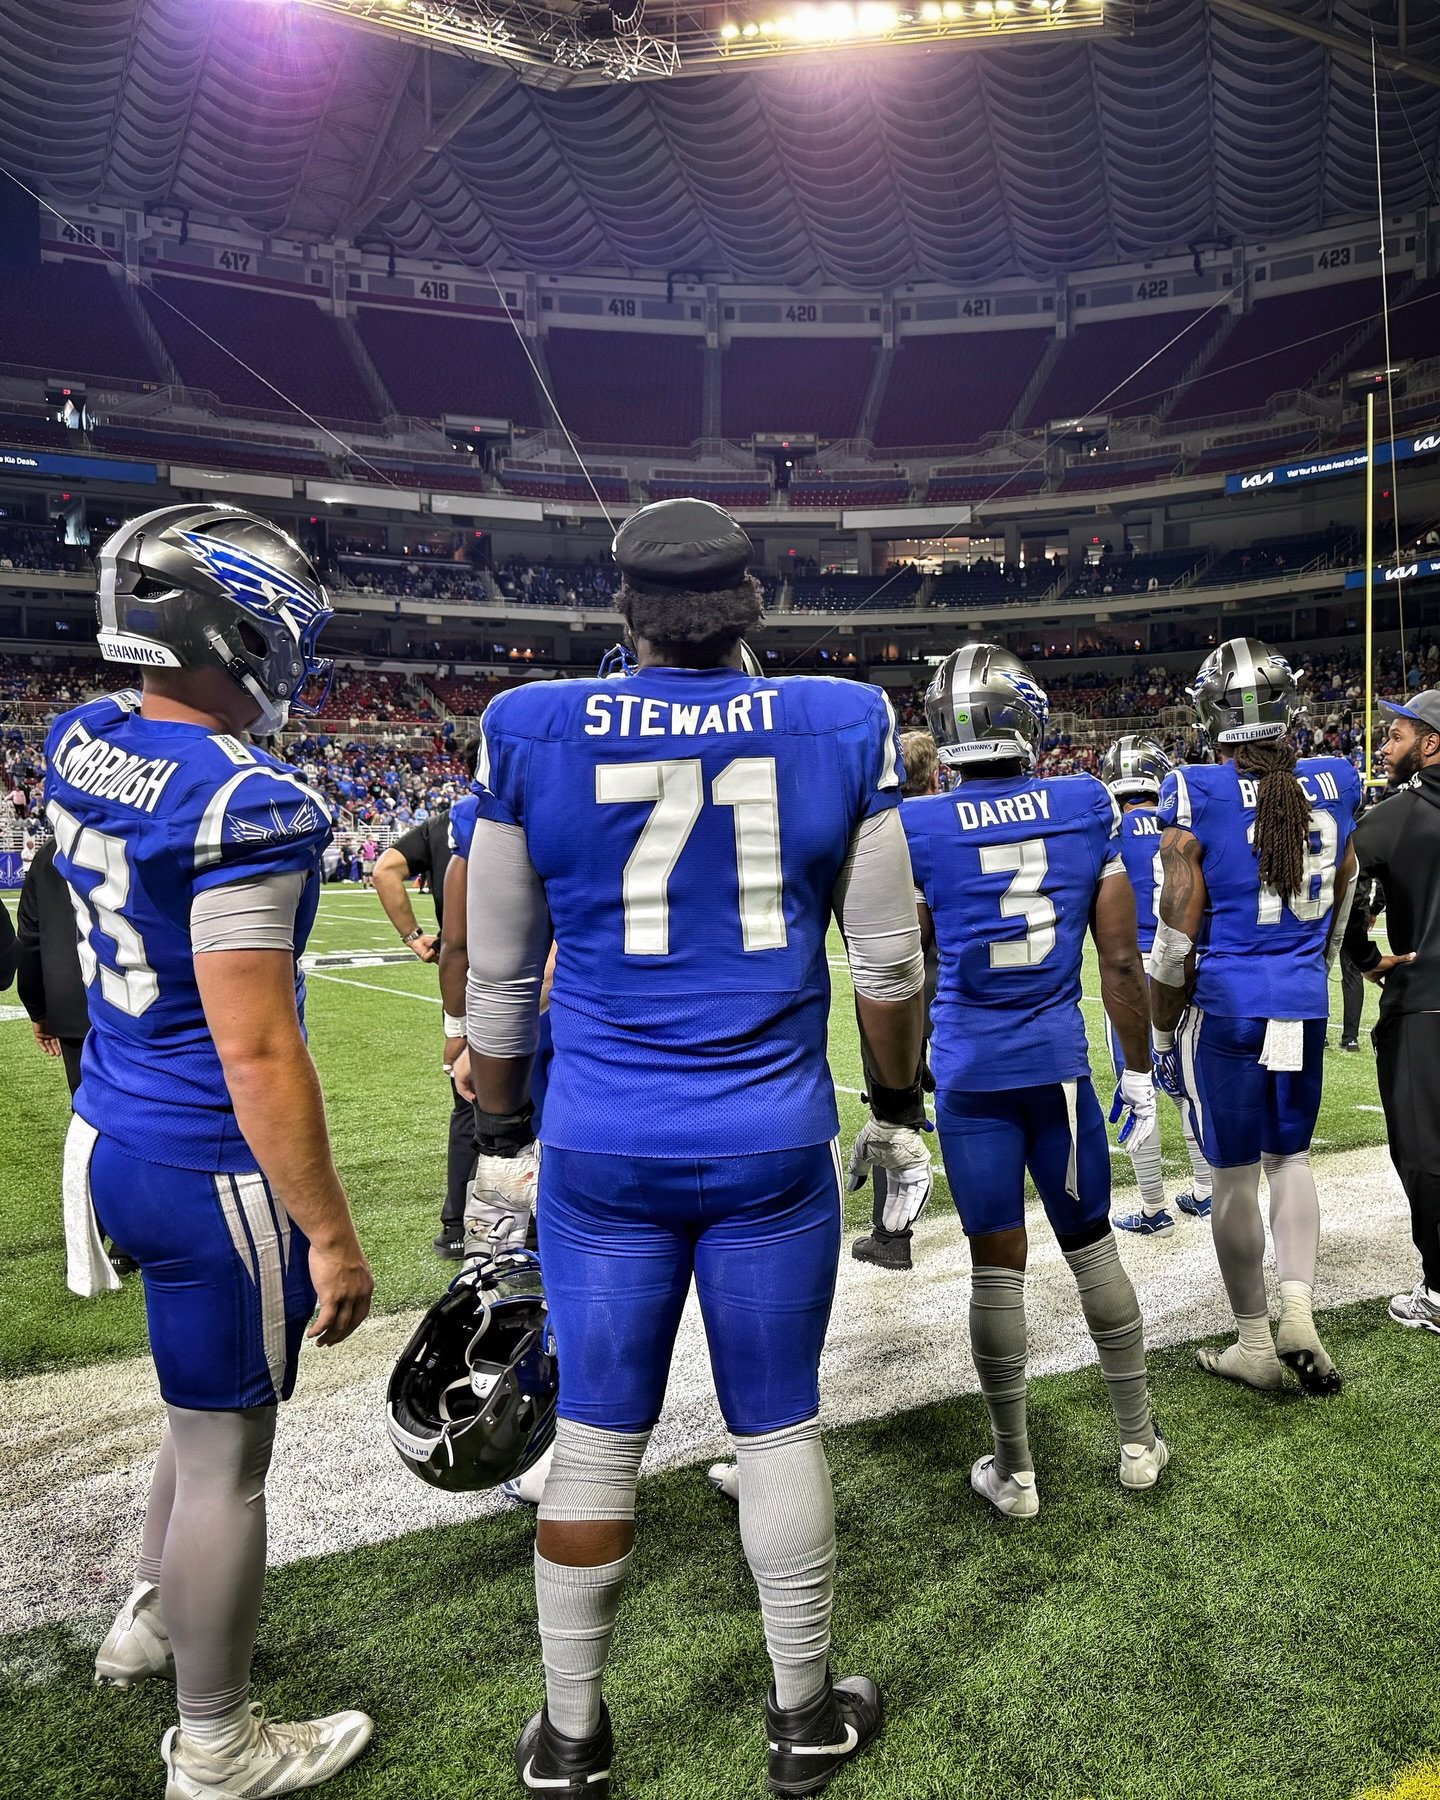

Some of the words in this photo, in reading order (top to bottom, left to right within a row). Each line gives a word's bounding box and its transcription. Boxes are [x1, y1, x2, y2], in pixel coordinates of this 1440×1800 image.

[218, 250, 251, 272] 417
[1317, 247, 1352, 268] 423
[420, 281, 450, 301] 418
[1136, 279, 1169, 299] 422
[608, 299, 636, 317] 419
[786, 305, 818, 323] 420
[962, 299, 992, 317] 421
[584, 689, 779, 737] STEWART
[1225, 725, 1284, 741] BATTLEHAWKS
[951, 743, 993, 754] BATTLEHAWKS
[1313, 771, 1340, 801] III
[956, 790, 1051, 830] DARBY
[595, 757, 788, 956] 71
[978, 838, 1057, 969] 3
